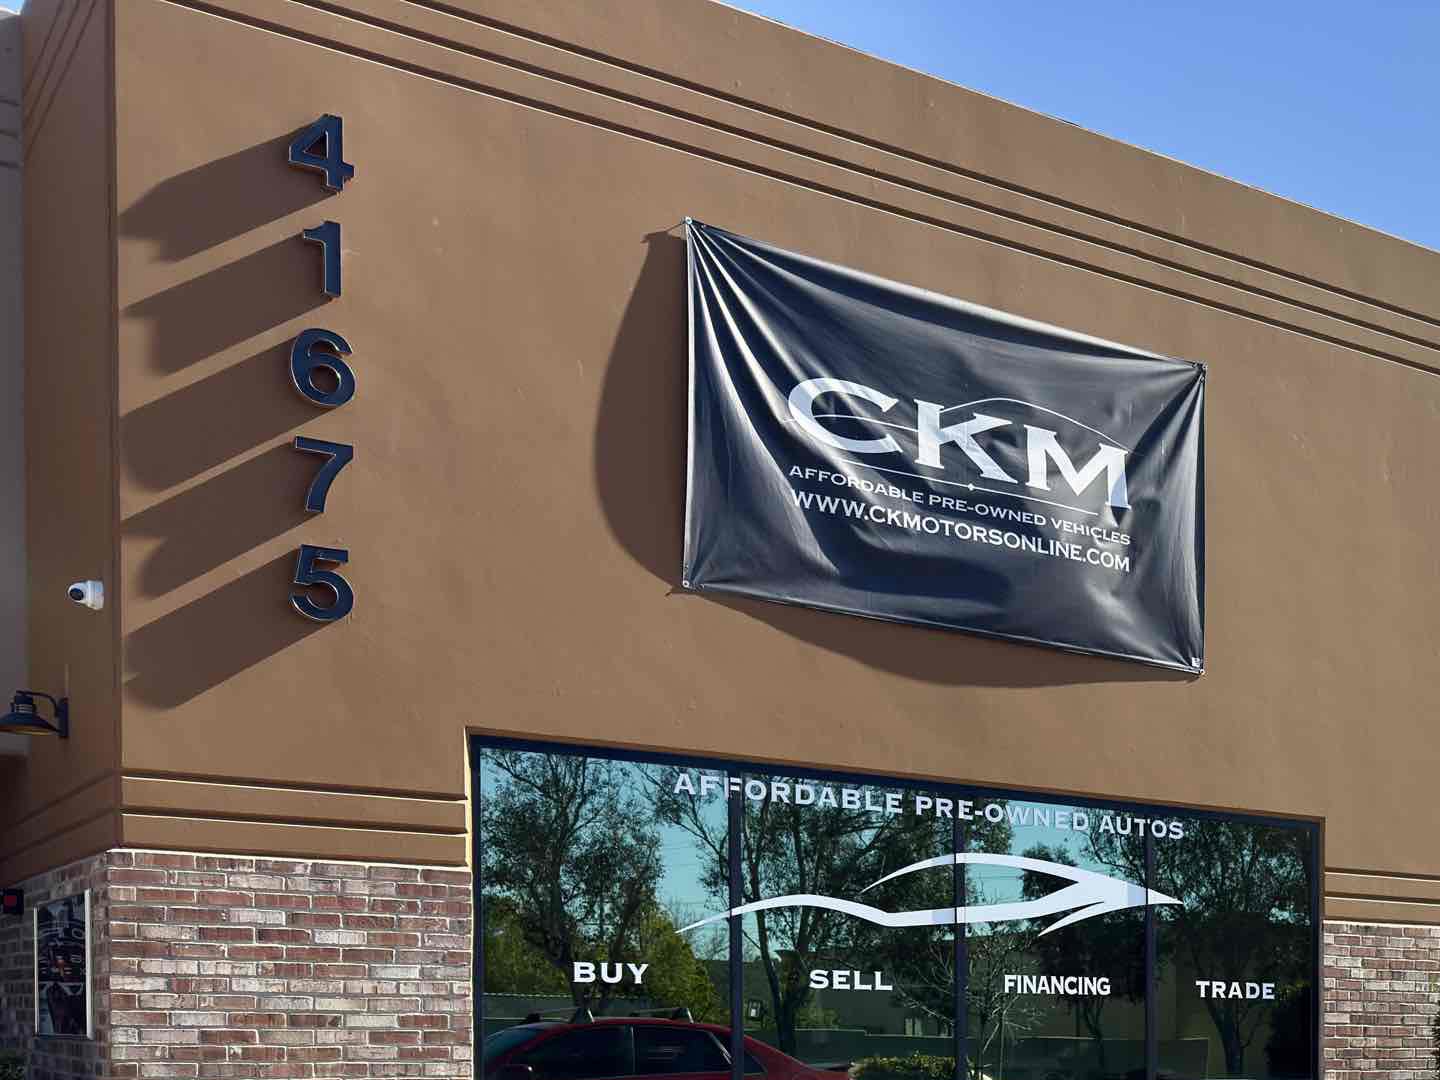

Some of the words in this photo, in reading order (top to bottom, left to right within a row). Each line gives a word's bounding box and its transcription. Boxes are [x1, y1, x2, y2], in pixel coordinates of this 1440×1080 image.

[288, 113, 356, 622] 41675
[787, 376, 1132, 510] CKM
[789, 465, 924, 504] AFFORDABLE
[929, 494, 1046, 526] PRE-OWNED
[1051, 518, 1131, 546] VEHICLES
[791, 489, 1130, 573] WWW.CKMOTORSONLINE.COM
[673, 772, 903, 814] AFFORDABLE
[915, 795, 1088, 831] PRE-OWNED
[1099, 815, 1184, 840] AUTOS
[573, 961, 649, 984] BUY
[809, 969, 893, 991] SELL
[1003, 974, 1112, 996] FINANCING
[1195, 980, 1275, 1000] TRADE
